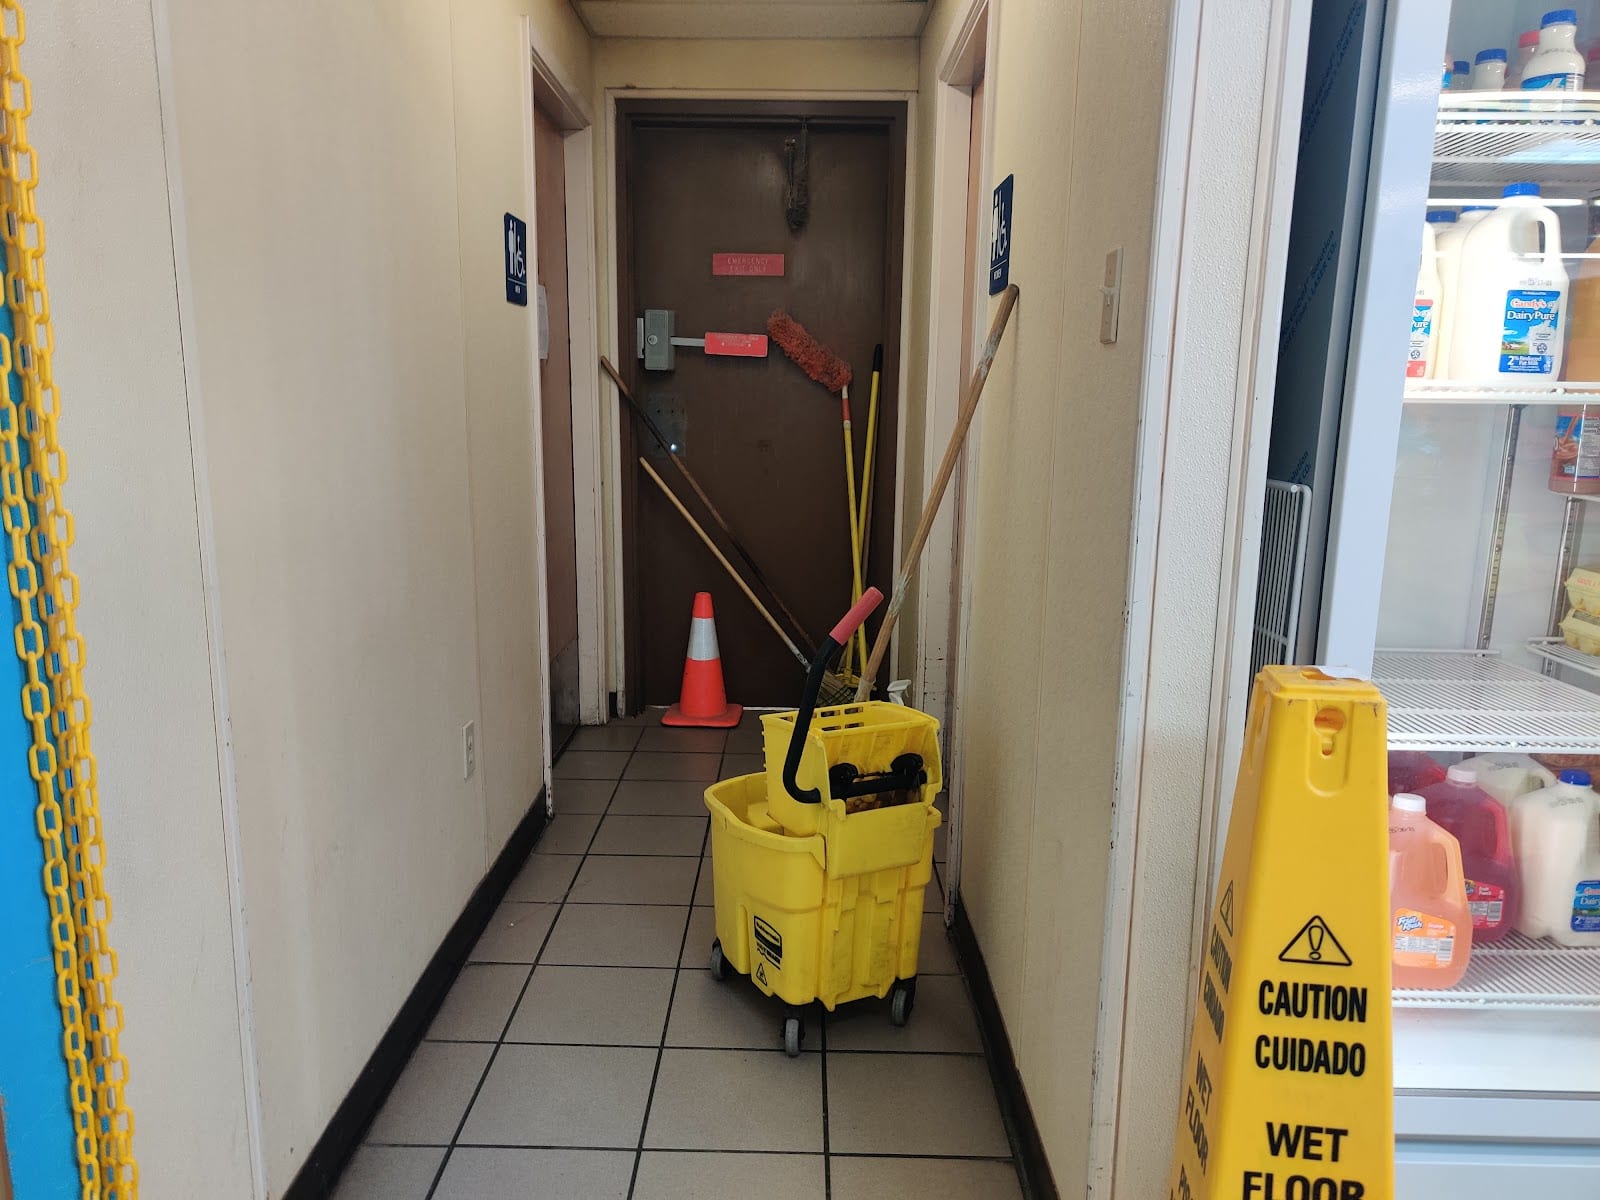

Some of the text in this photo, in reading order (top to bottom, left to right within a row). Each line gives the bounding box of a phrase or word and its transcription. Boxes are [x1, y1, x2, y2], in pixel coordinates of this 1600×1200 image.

[727, 257, 768, 265] EMERGENCY
[1258, 979, 1367, 1022] CAUTION
[1255, 1034, 1366, 1077] CUIDADO
[1195, 1049, 1213, 1116] WET
[1265, 1121, 1349, 1163] WET
[1242, 1170, 1366, 1200] FLOOR
